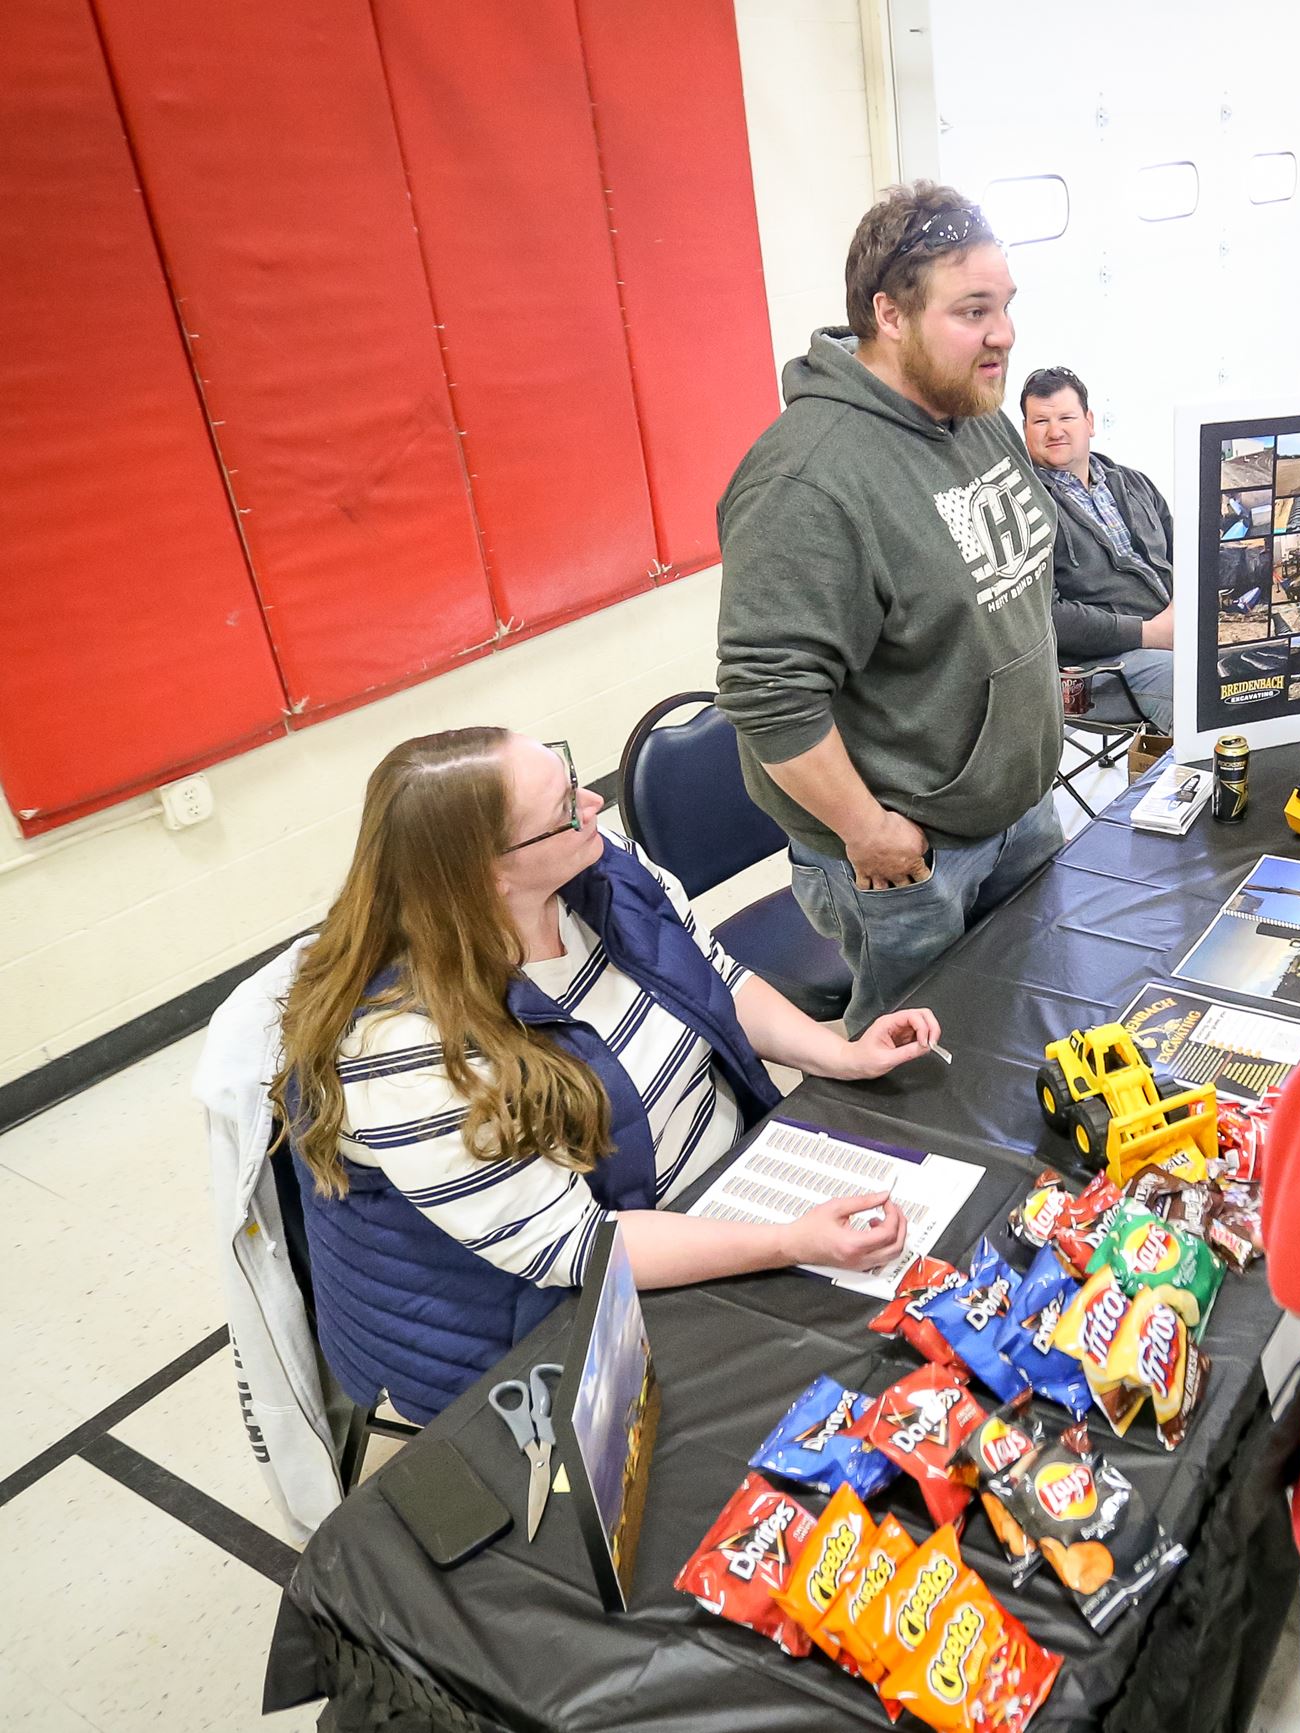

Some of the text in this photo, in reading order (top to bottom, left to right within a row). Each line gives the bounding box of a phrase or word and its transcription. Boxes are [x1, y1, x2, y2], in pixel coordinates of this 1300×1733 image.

[1221, 675, 1285, 700] BREIDENBACH
[1230, 690, 1274, 703] EXCAVATING
[1127, 997, 1178, 1036] DENBACH
[1156, 1010, 1202, 1064] EXCAVATING
[1085, 1202, 1121, 1249] Dorito
[1137, 1303, 1177, 1398] Fritos
[802, 1389, 859, 1453] Doritos
[728, 1500, 796, 1580] Doritos
[809, 1523, 857, 1612] Cheetos
[898, 1558, 955, 1648] Cheetos
[930, 1606, 981, 1699] Cheetos
